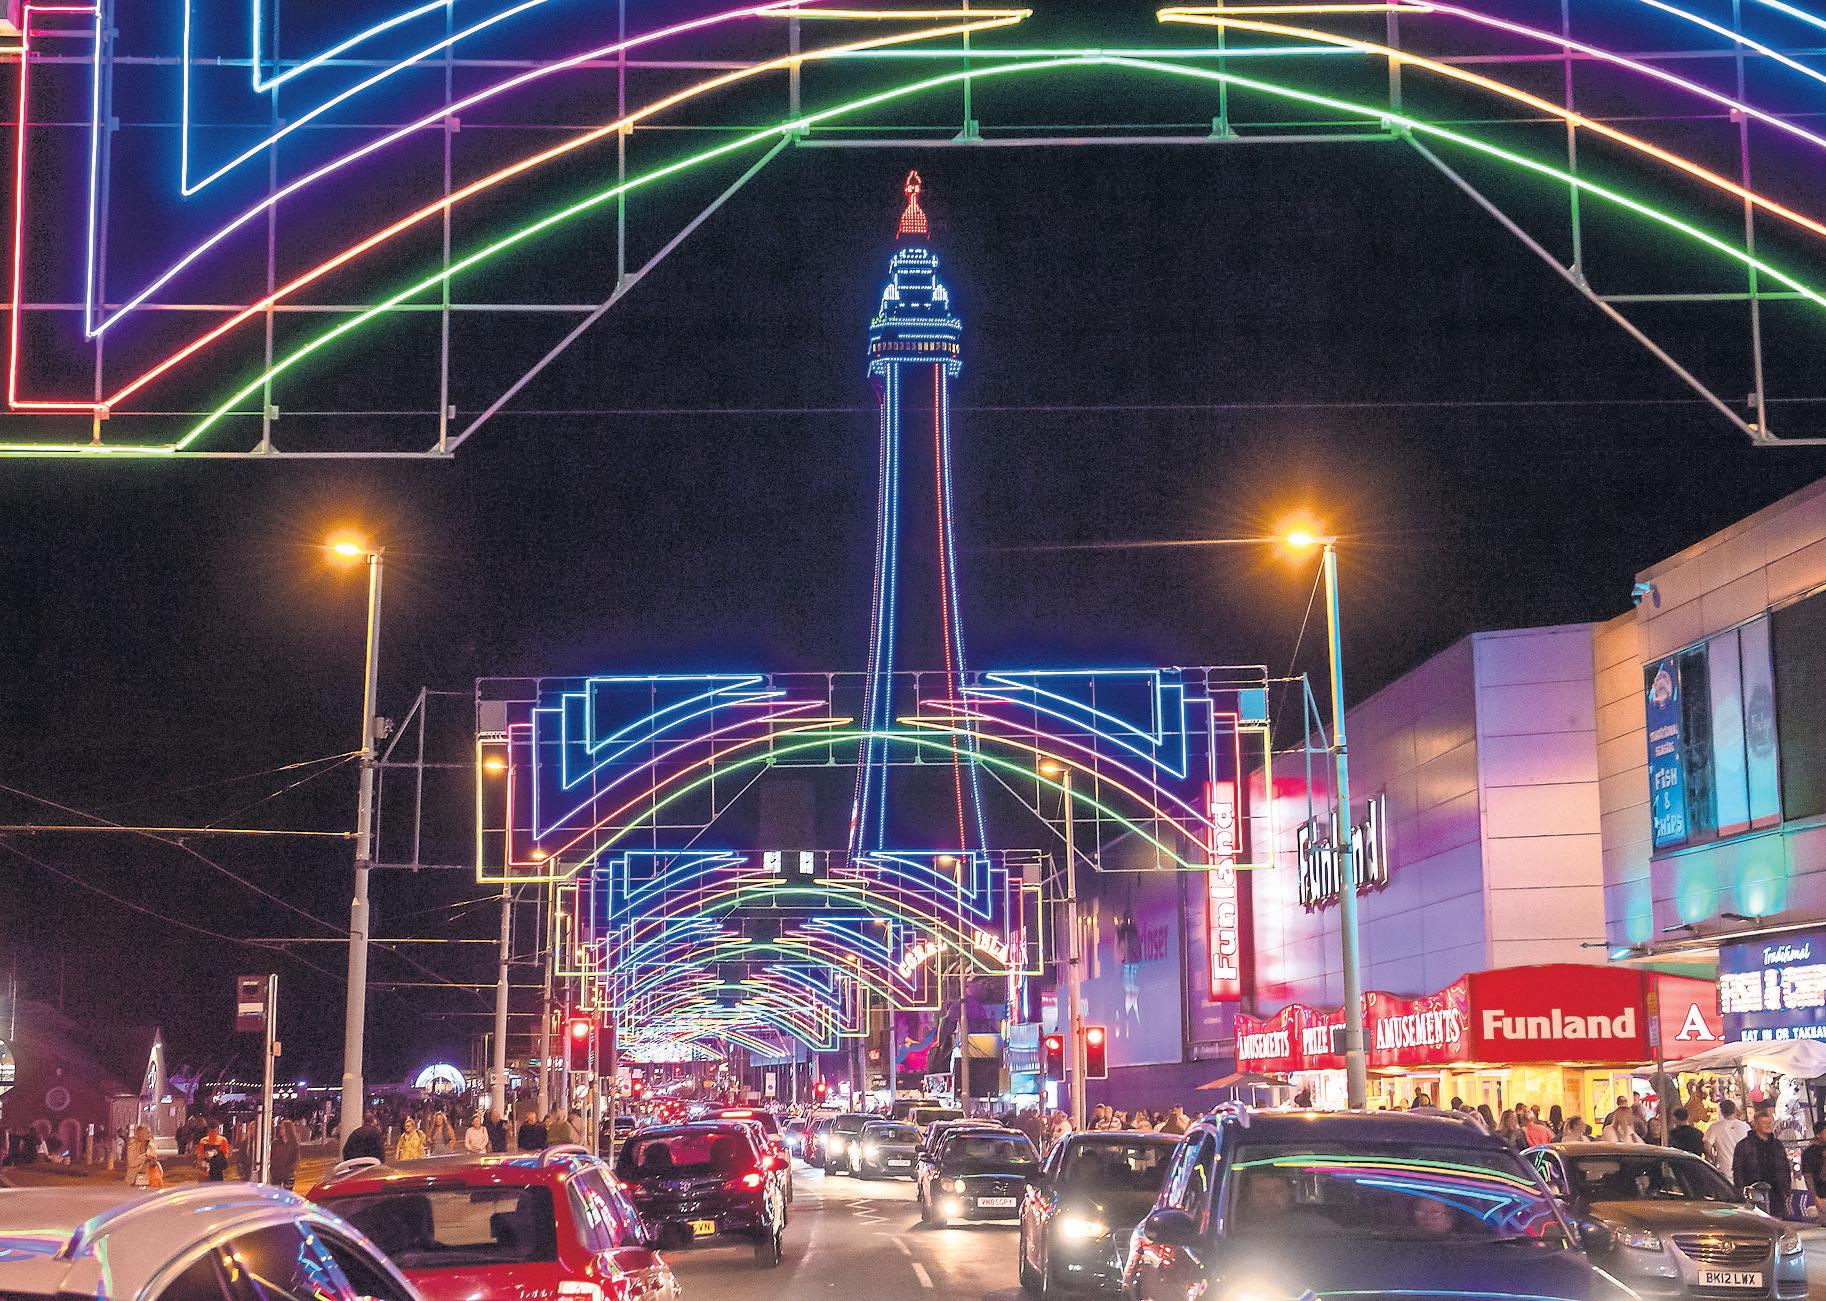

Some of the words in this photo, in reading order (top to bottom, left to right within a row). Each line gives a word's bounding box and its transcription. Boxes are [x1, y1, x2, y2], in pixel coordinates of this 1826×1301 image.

[1298, 793, 1388, 905] Funlnd
[1210, 802, 1237, 980] Funland
[1238, 1029, 1290, 1060] AMUSEMENTS
[1376, 1007, 1461, 1050] AMUSEMENTS
[1482, 1007, 1636, 1040] Funland
